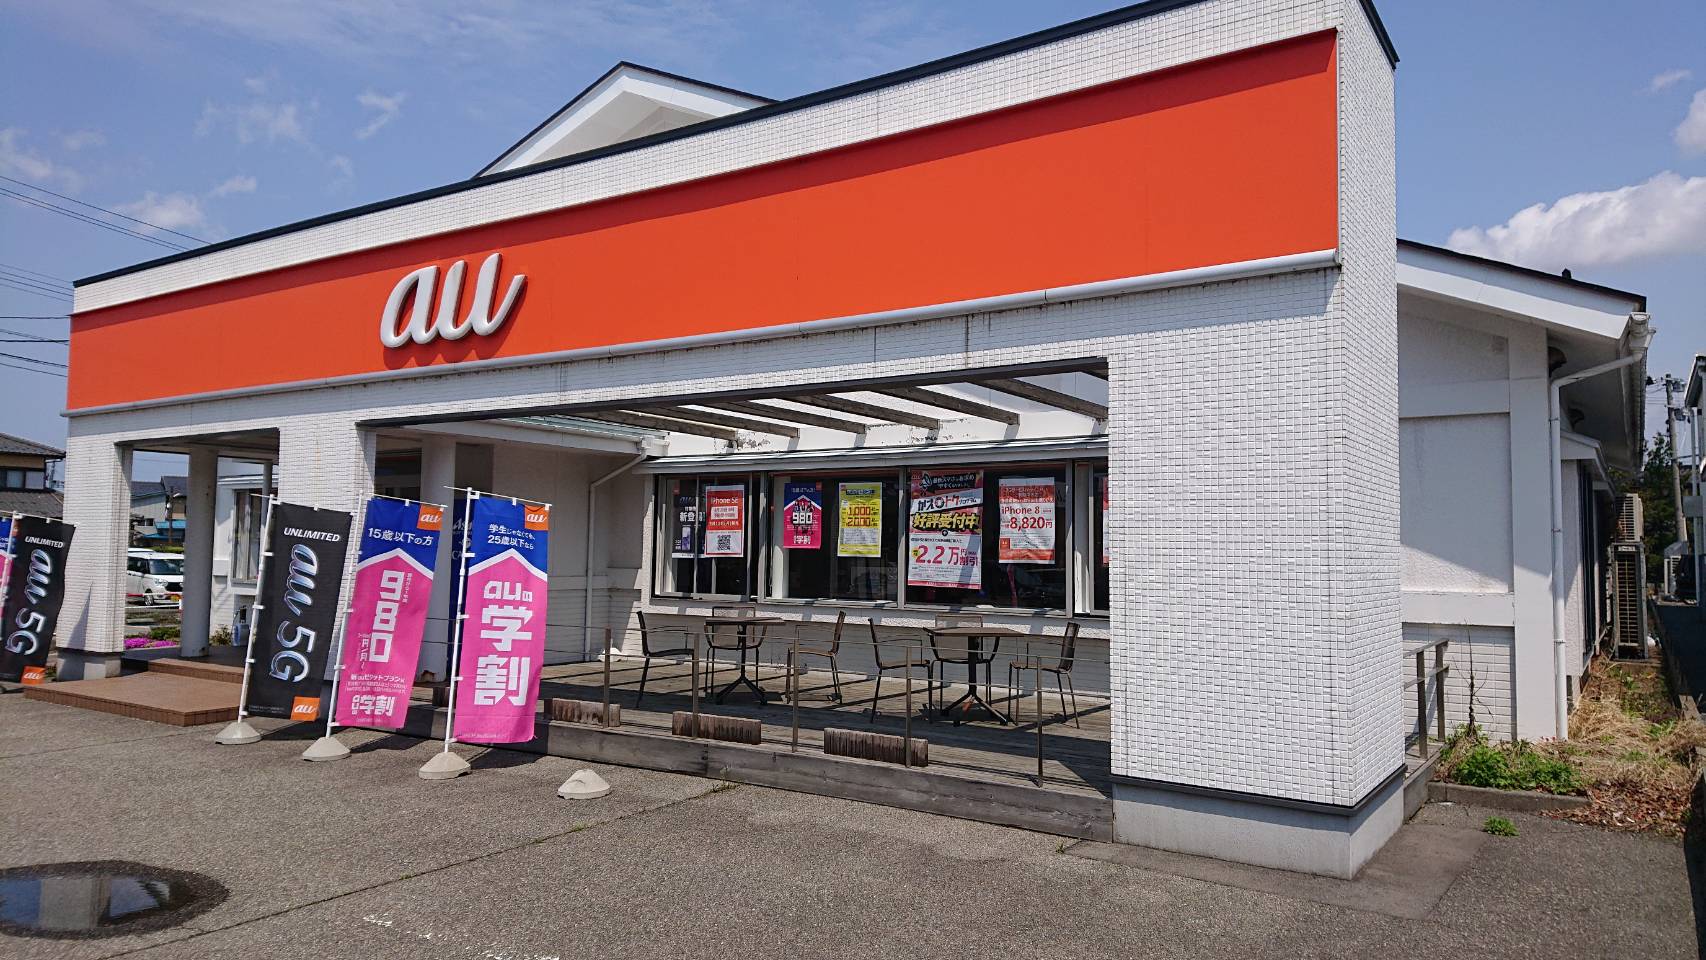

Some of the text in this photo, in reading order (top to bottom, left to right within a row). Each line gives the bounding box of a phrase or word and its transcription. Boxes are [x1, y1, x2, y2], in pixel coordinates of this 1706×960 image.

[380, 252, 526, 348] au
[1001, 506, 1033, 515] iPhone
[1034, 506, 1041, 515] 8
[421, 514, 441, 524] au
[526, 513, 547, 523] au
[792, 511, 813, 525] 980
[912, 512, 979, 529] 好評受付中
[25, 535, 64, 548] UNLIMITED
[283, 527, 341, 542] UNLIMITED
[368, 527, 434, 546] 15歳以下の方
[487, 534, 534, 550] 25歳以下なら
[4, 549, 51, 656] au 5G
[270, 543, 319, 683] au 5G
[23, 672, 43, 680] au
[293, 703, 316, 714] au
